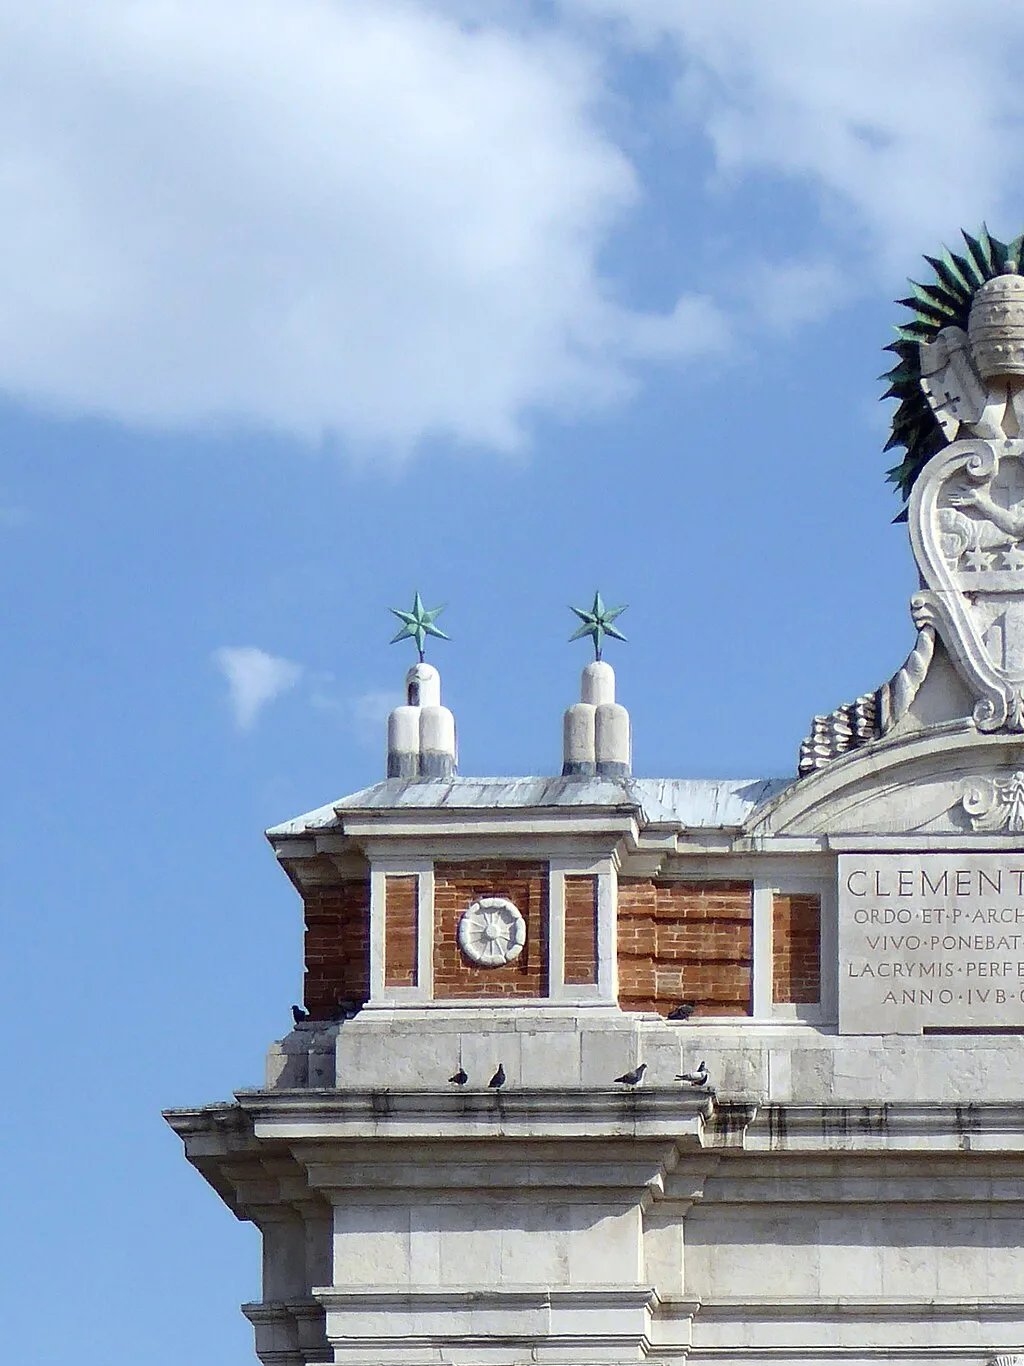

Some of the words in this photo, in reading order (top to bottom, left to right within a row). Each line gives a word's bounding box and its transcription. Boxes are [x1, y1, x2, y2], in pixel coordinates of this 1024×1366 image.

[854, 908, 912, 924] ORDO
[922, 908, 945, 924] ET
[952, 908, 962, 924] P
[866, 935, 920, 950] VIVO
[930, 935, 1022, 950] PONEBAT
[849, 962, 954, 978] LACRYMIS
[881, 989, 953, 1004] ANNO
[967, 989, 1007, 1004] IVB
